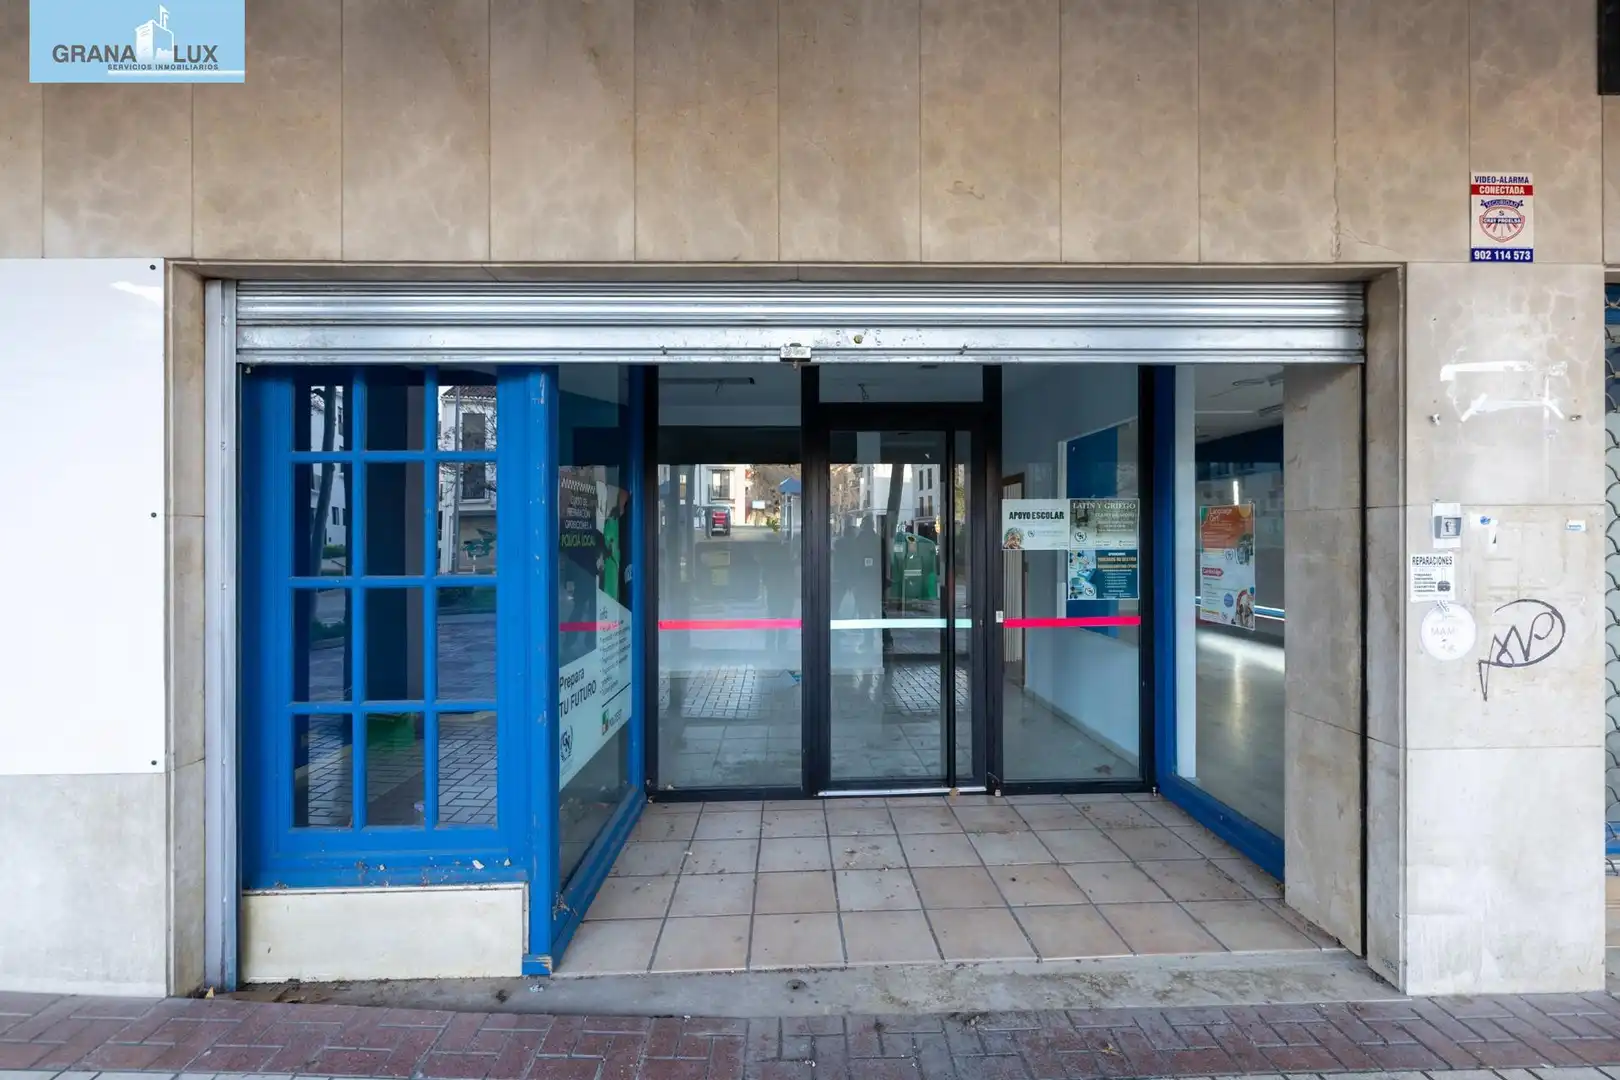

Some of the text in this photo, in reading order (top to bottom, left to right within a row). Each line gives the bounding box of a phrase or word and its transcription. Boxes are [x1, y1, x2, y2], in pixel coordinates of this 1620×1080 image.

[1479, 186, 1525, 194] CONECTADA
[1474, 250, 1531, 260] 902 114 573
[1104, 501, 1136, 509] GRIEGO
[1009, 511, 1065, 520] APOYO ESCOLAR
[1412, 556, 1453, 565] REPARACIONES
[559, 667, 585, 693] Prepara
[559, 679, 597, 718] TU FUTURO
